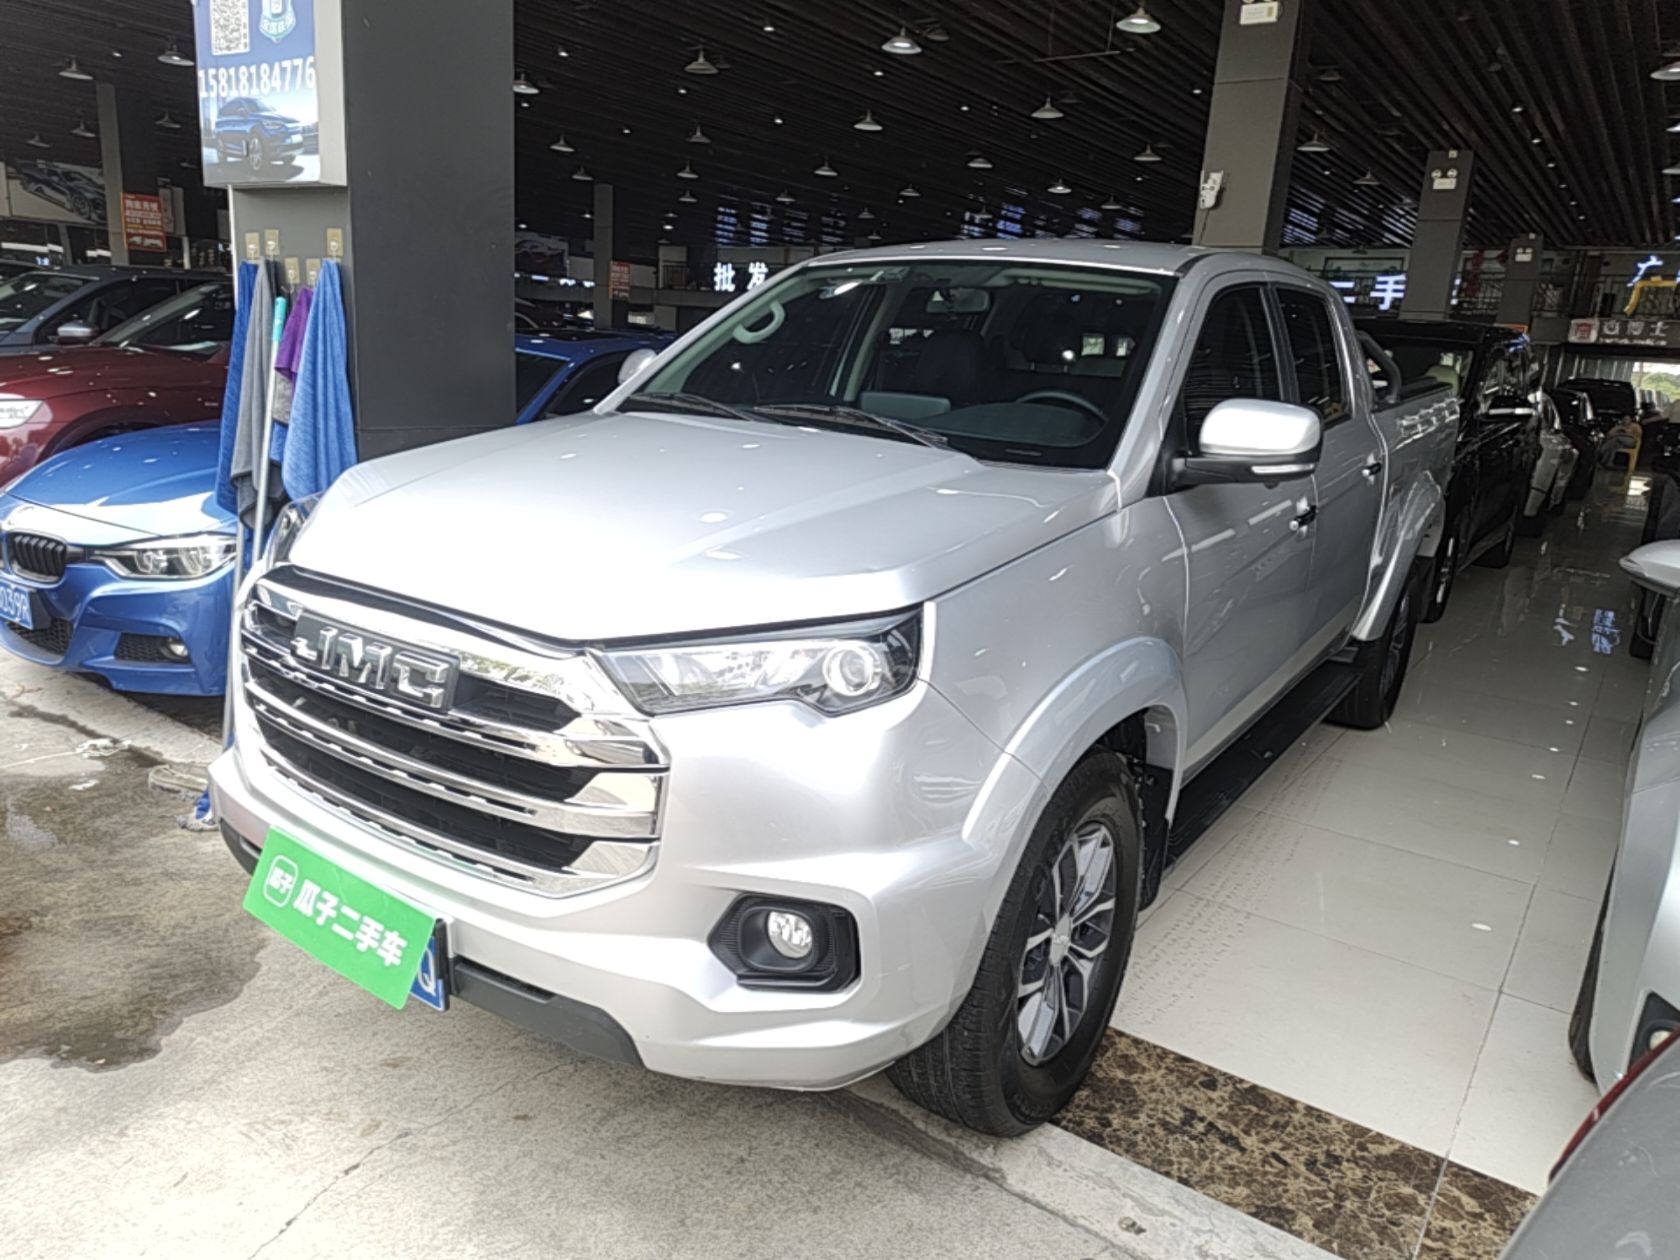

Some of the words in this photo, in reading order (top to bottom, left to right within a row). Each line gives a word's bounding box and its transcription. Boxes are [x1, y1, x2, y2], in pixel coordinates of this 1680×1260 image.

[198, 55, 316, 97] 15818184776
[713, 261, 769, 292] 批发
[291, 626, 450, 709] JMC
[293, 879, 408, 967] 瓜子二手车
